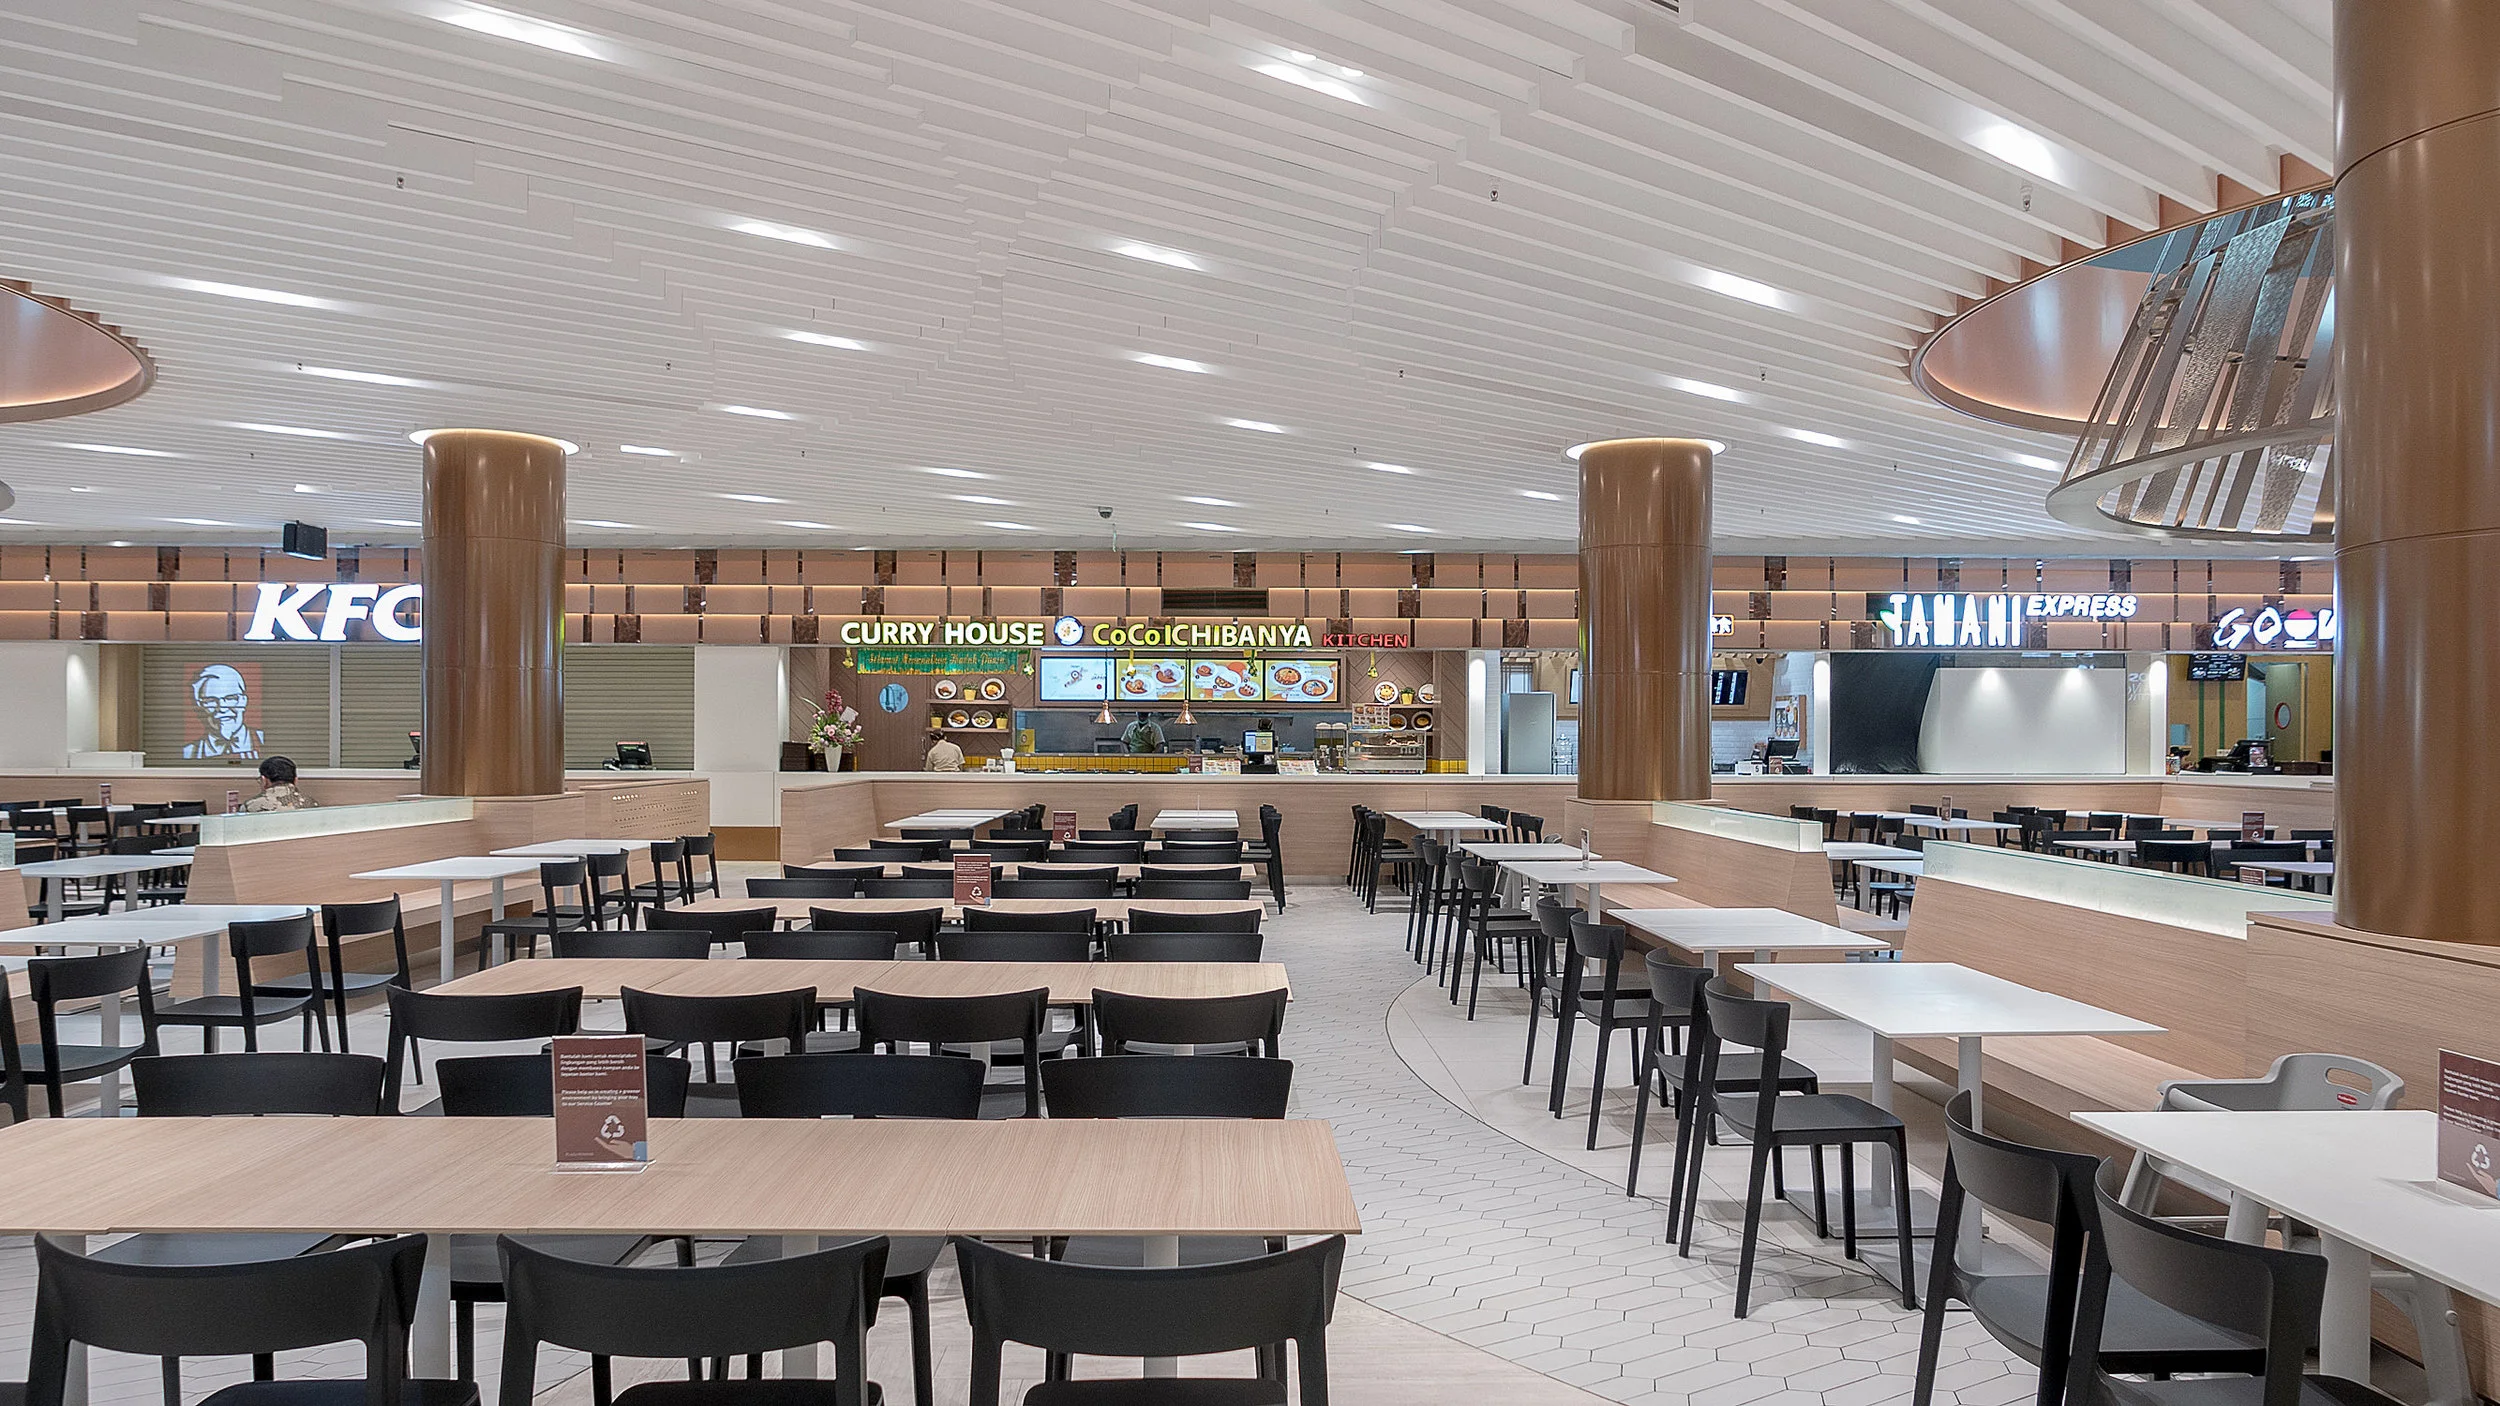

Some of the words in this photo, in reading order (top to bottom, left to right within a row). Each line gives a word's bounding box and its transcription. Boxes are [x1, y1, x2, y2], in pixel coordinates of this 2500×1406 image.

[243, 582, 422, 643] KFC
[840, 621, 935, 645] CURRY
[944, 621, 1045, 646] HOUSE
[1322, 632, 1409, 648] KITCHEN
[1886, 592, 2022, 648] TAMANI
[2025, 593, 2138, 617] EXPRESS
